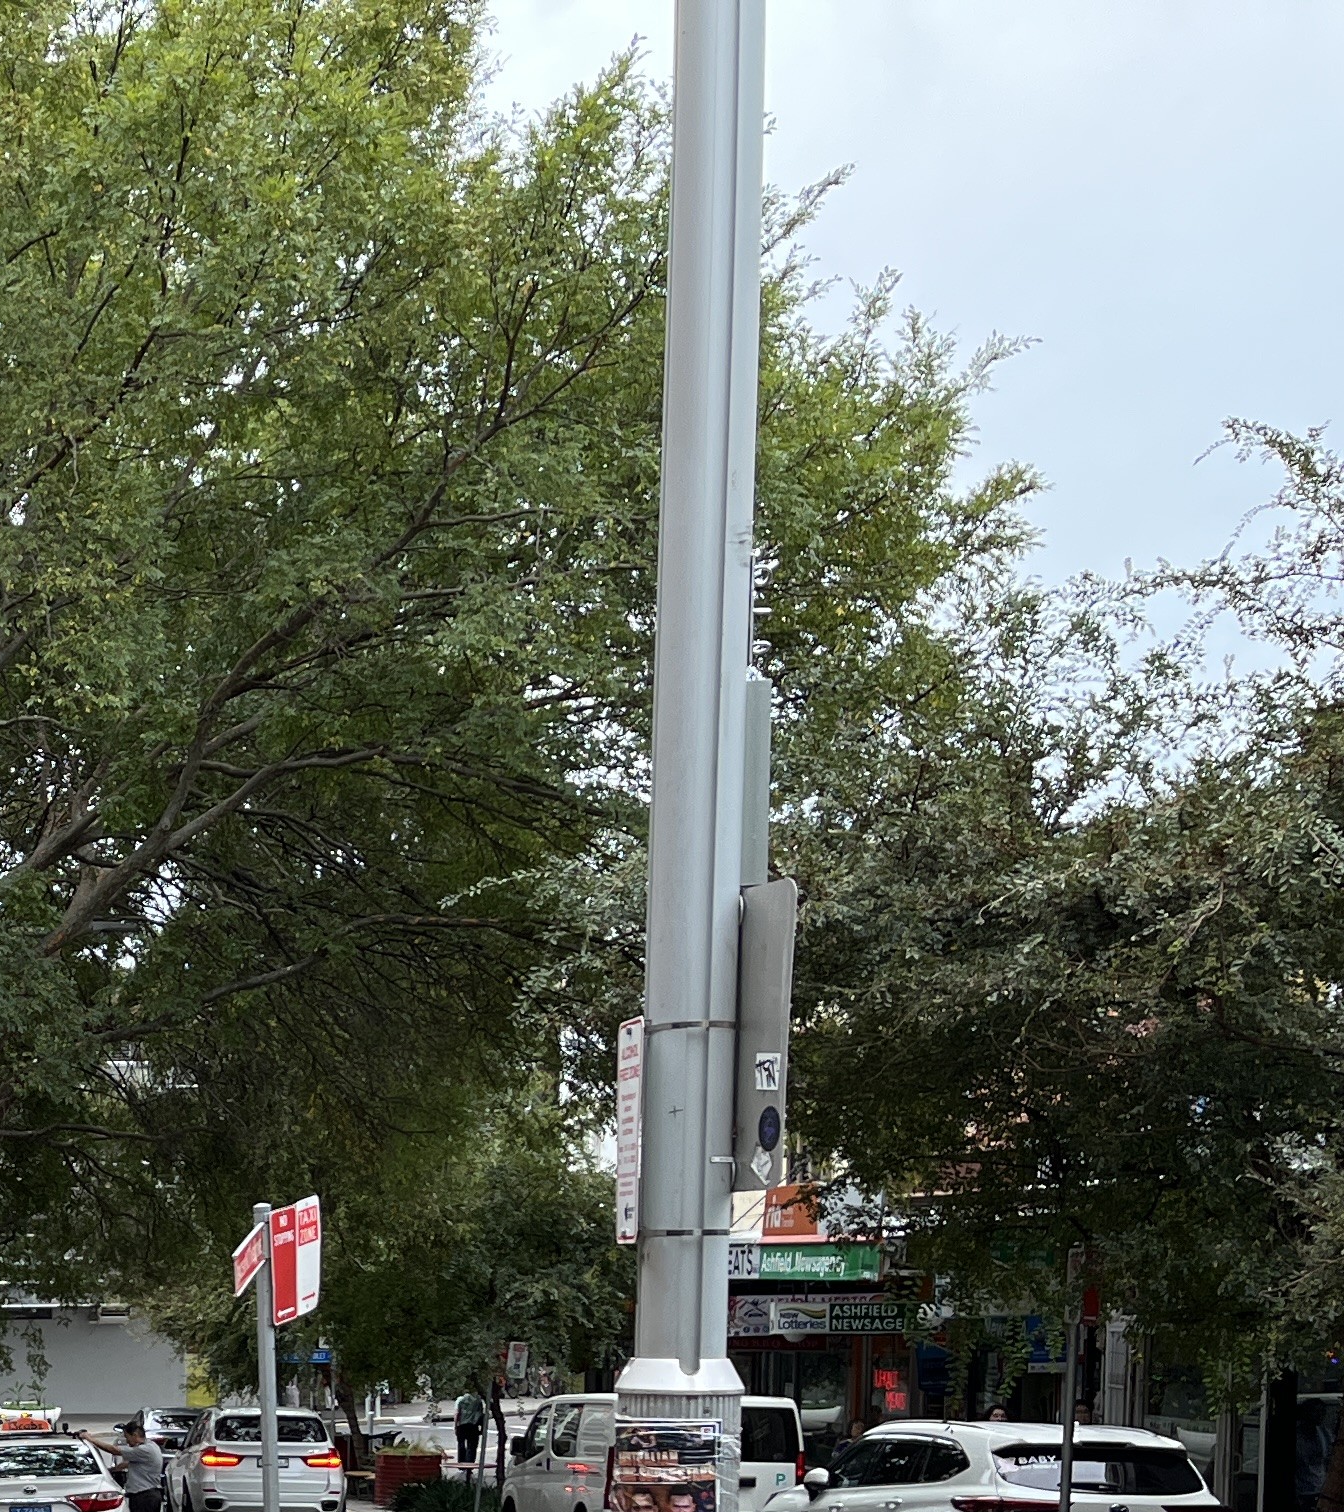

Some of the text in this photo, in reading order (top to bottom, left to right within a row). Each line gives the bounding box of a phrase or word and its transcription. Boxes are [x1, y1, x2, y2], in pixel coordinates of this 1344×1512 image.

[299, 1208, 317, 1226] TAXI
[299, 1225, 317, 1244] ZONE
[761, 1252, 792, 1272] Ashfield
[795, 1251, 845, 1278] Newsagency
[832, 1304, 898, 1317] ASHFIELD
[778, 1319, 827, 1330] Lotteries
[832, 1318, 904, 1331] NEWSAGE
[1018, 1455, 1056, 1465] BABY
